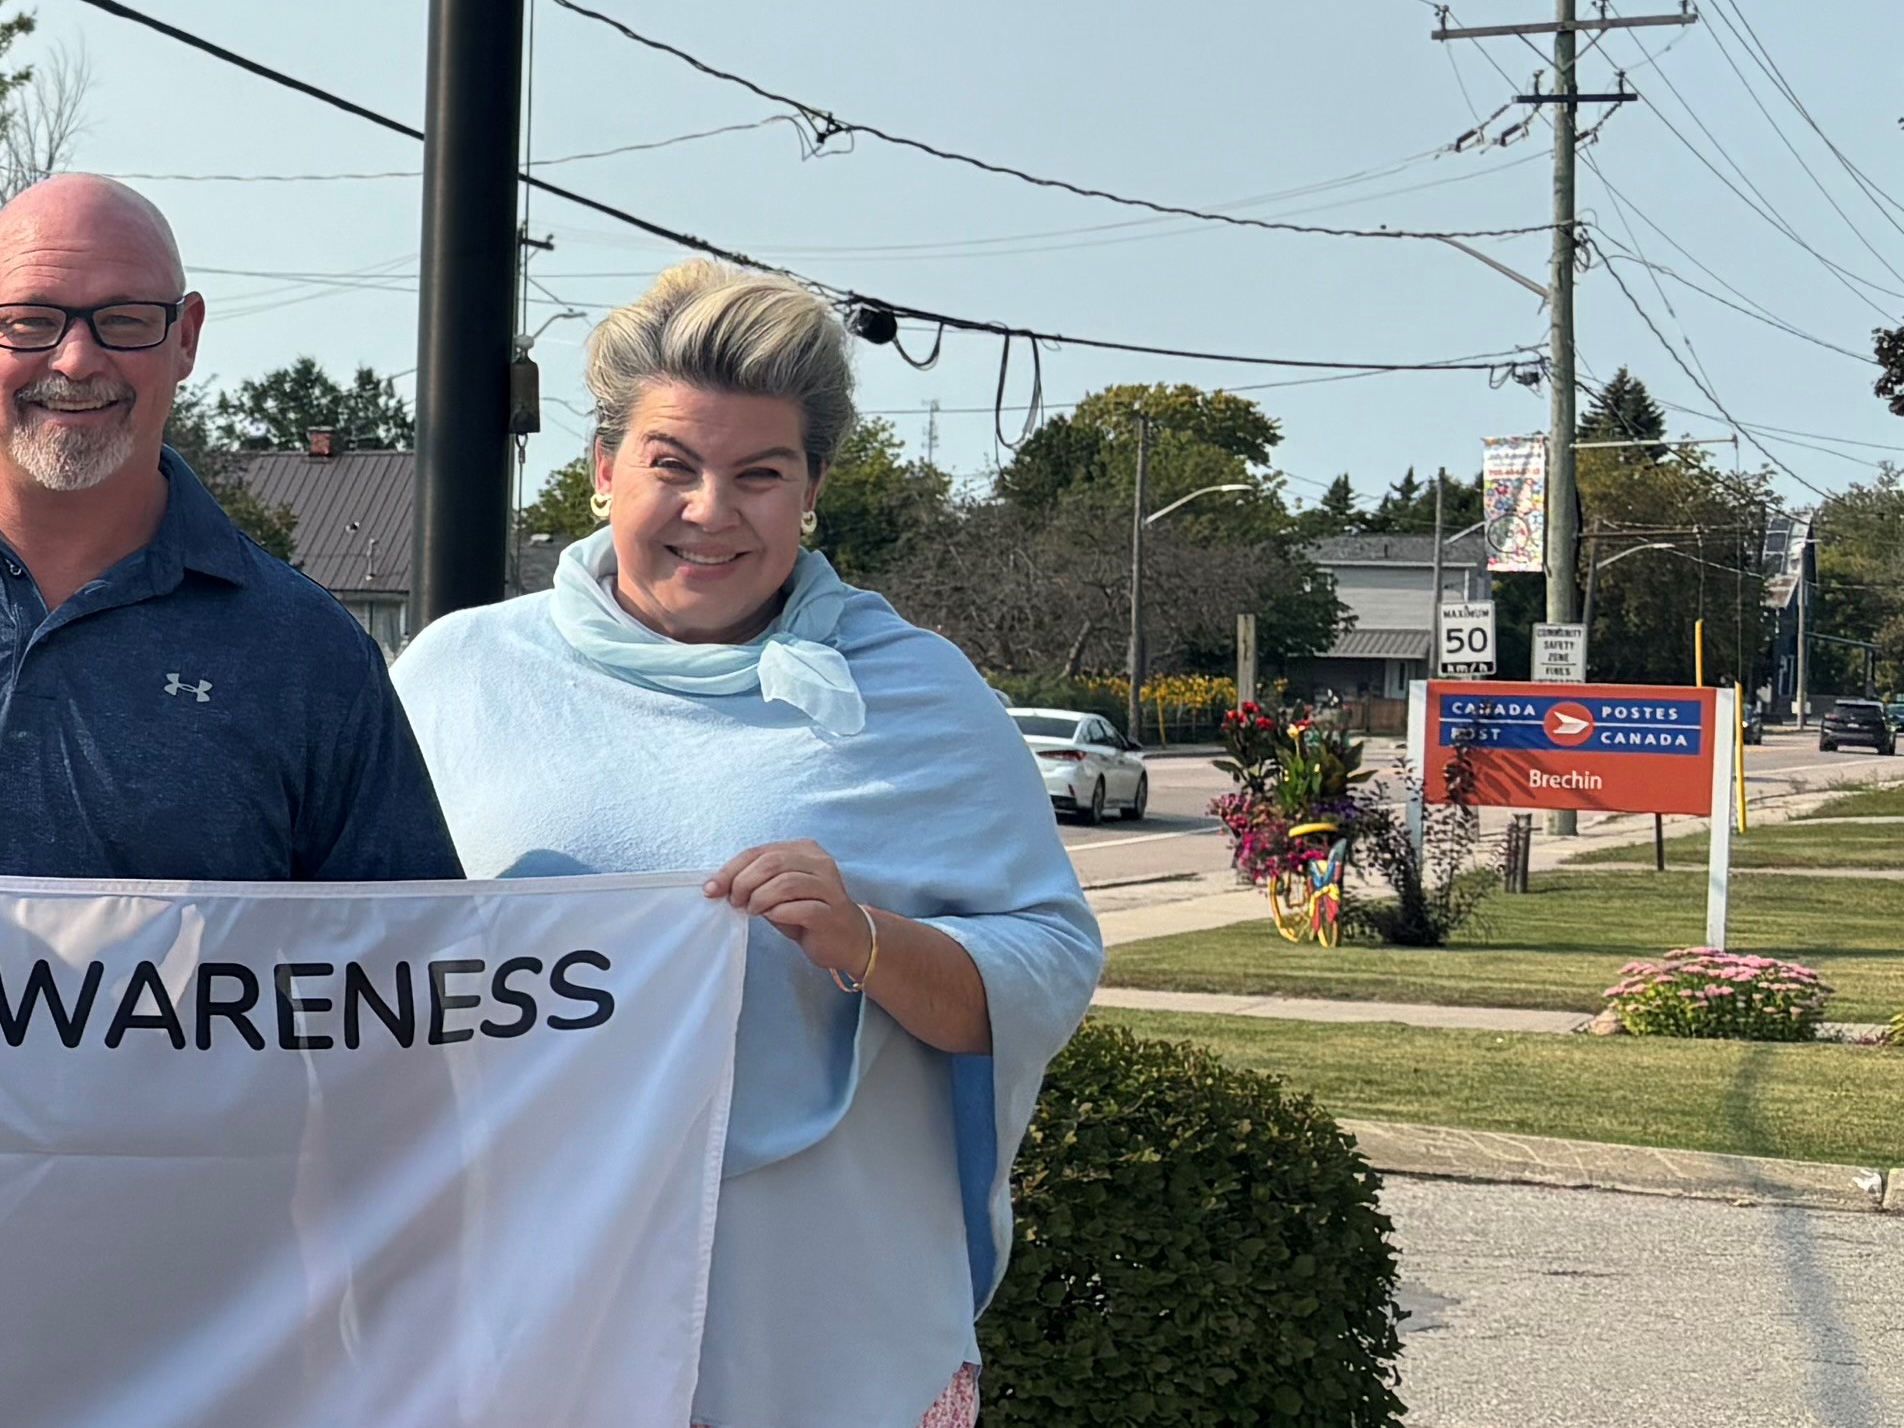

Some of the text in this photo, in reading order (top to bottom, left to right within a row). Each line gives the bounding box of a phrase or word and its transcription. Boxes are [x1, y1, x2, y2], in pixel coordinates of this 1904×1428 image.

[1443, 608, 1489, 619] MAXIMUM
[1446, 627, 1488, 654] 50
[1544, 640, 1574, 650] SAFETY
[1601, 706, 1679, 721] POSTES
[1600, 731, 1688, 747] CANADA
[1529, 769, 1603, 790] Brechin
